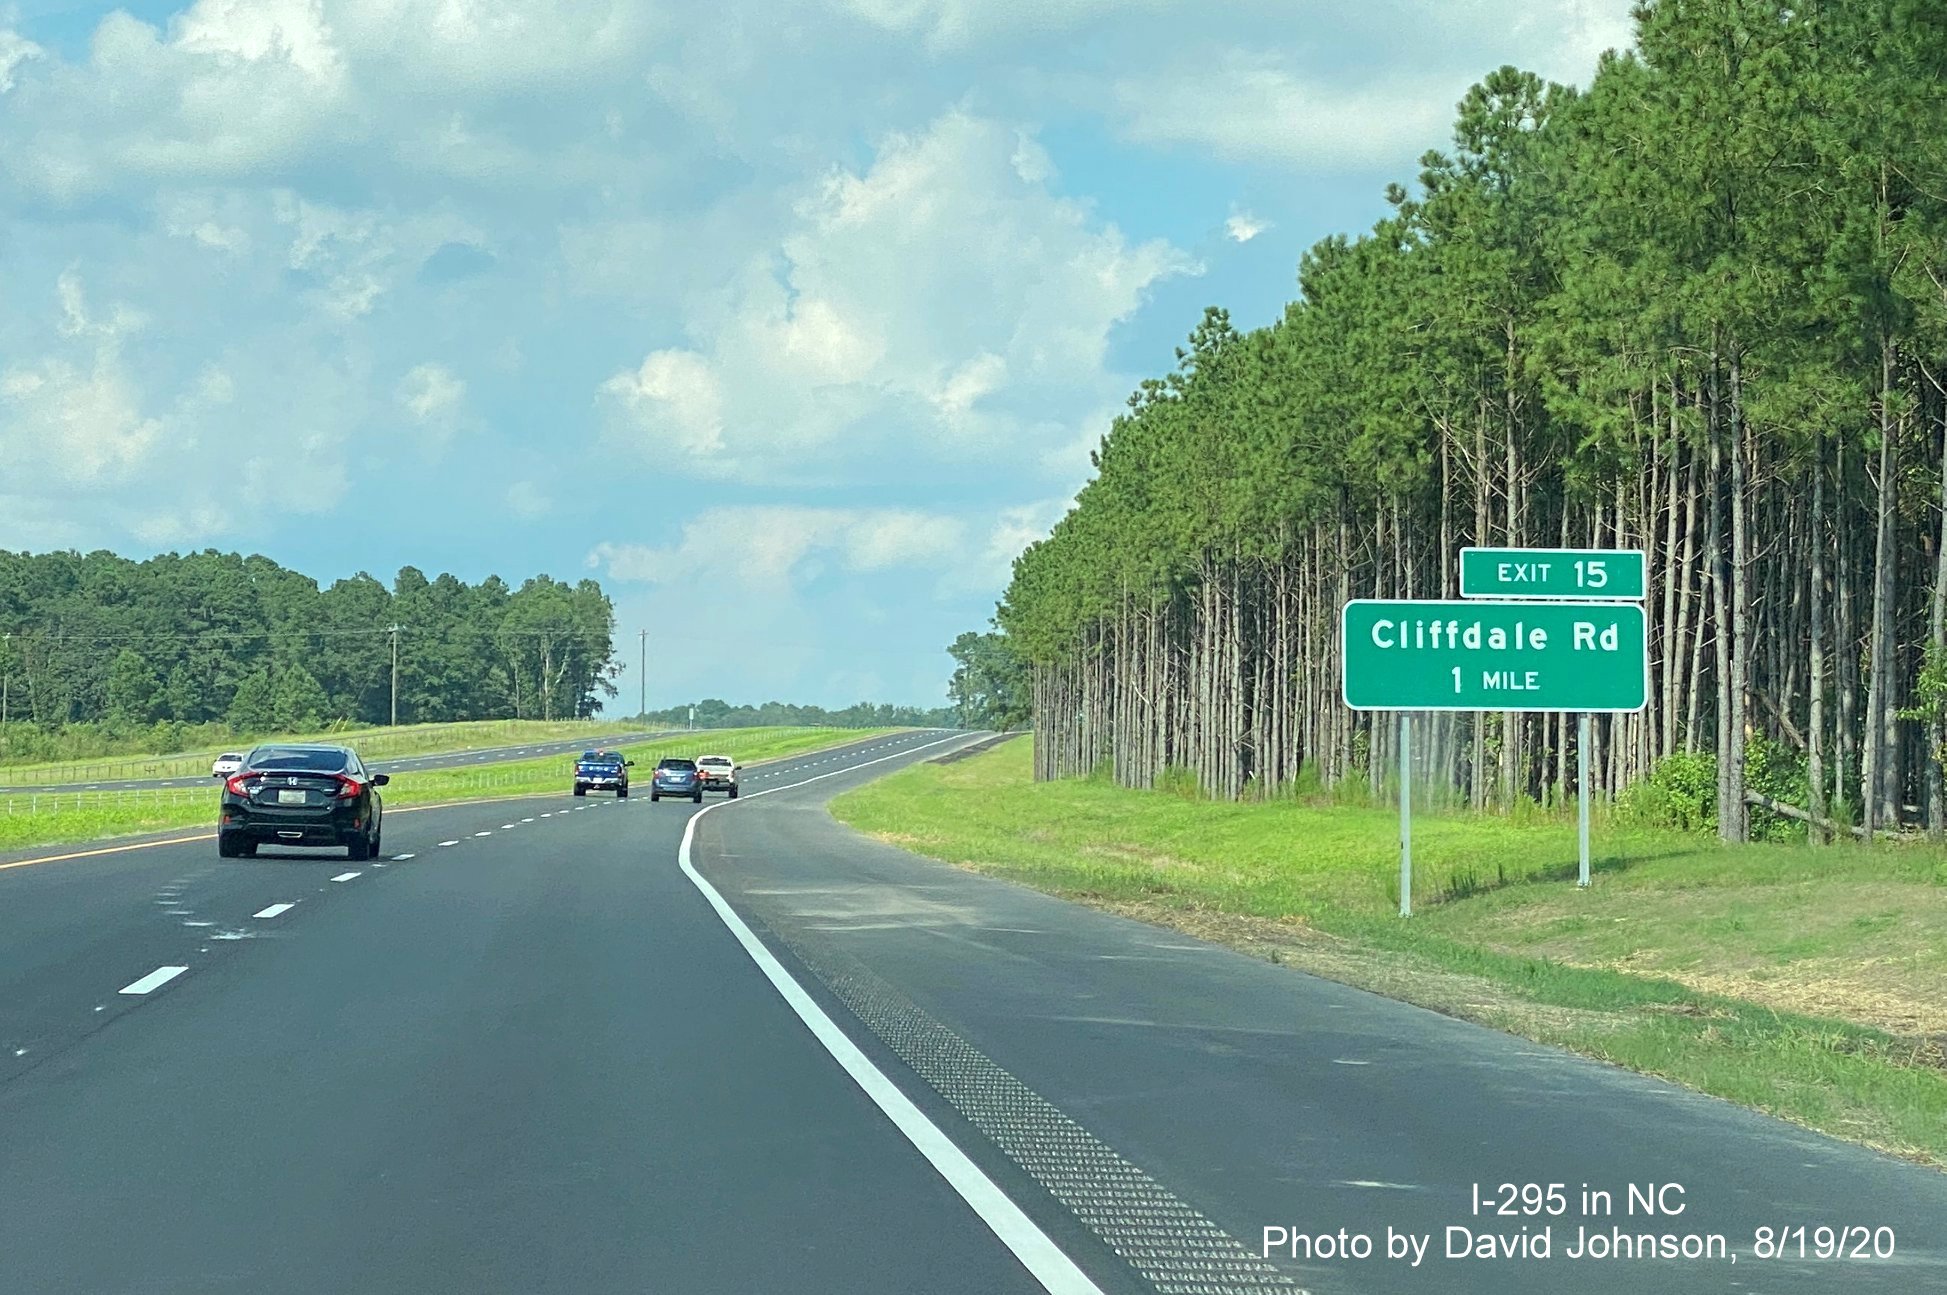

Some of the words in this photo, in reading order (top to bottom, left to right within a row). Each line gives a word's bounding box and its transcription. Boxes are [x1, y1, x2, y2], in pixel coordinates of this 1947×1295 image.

[1498, 563, 1551, 582] EXIT
[1574, 560, 1608, 588] 15
[1371, 619, 1548, 650] Cliffdale
[1573, 621, 1618, 651] Rd
[1451, 666, 1461, 694] 1
[1483, 671, 1540, 690] MILE
